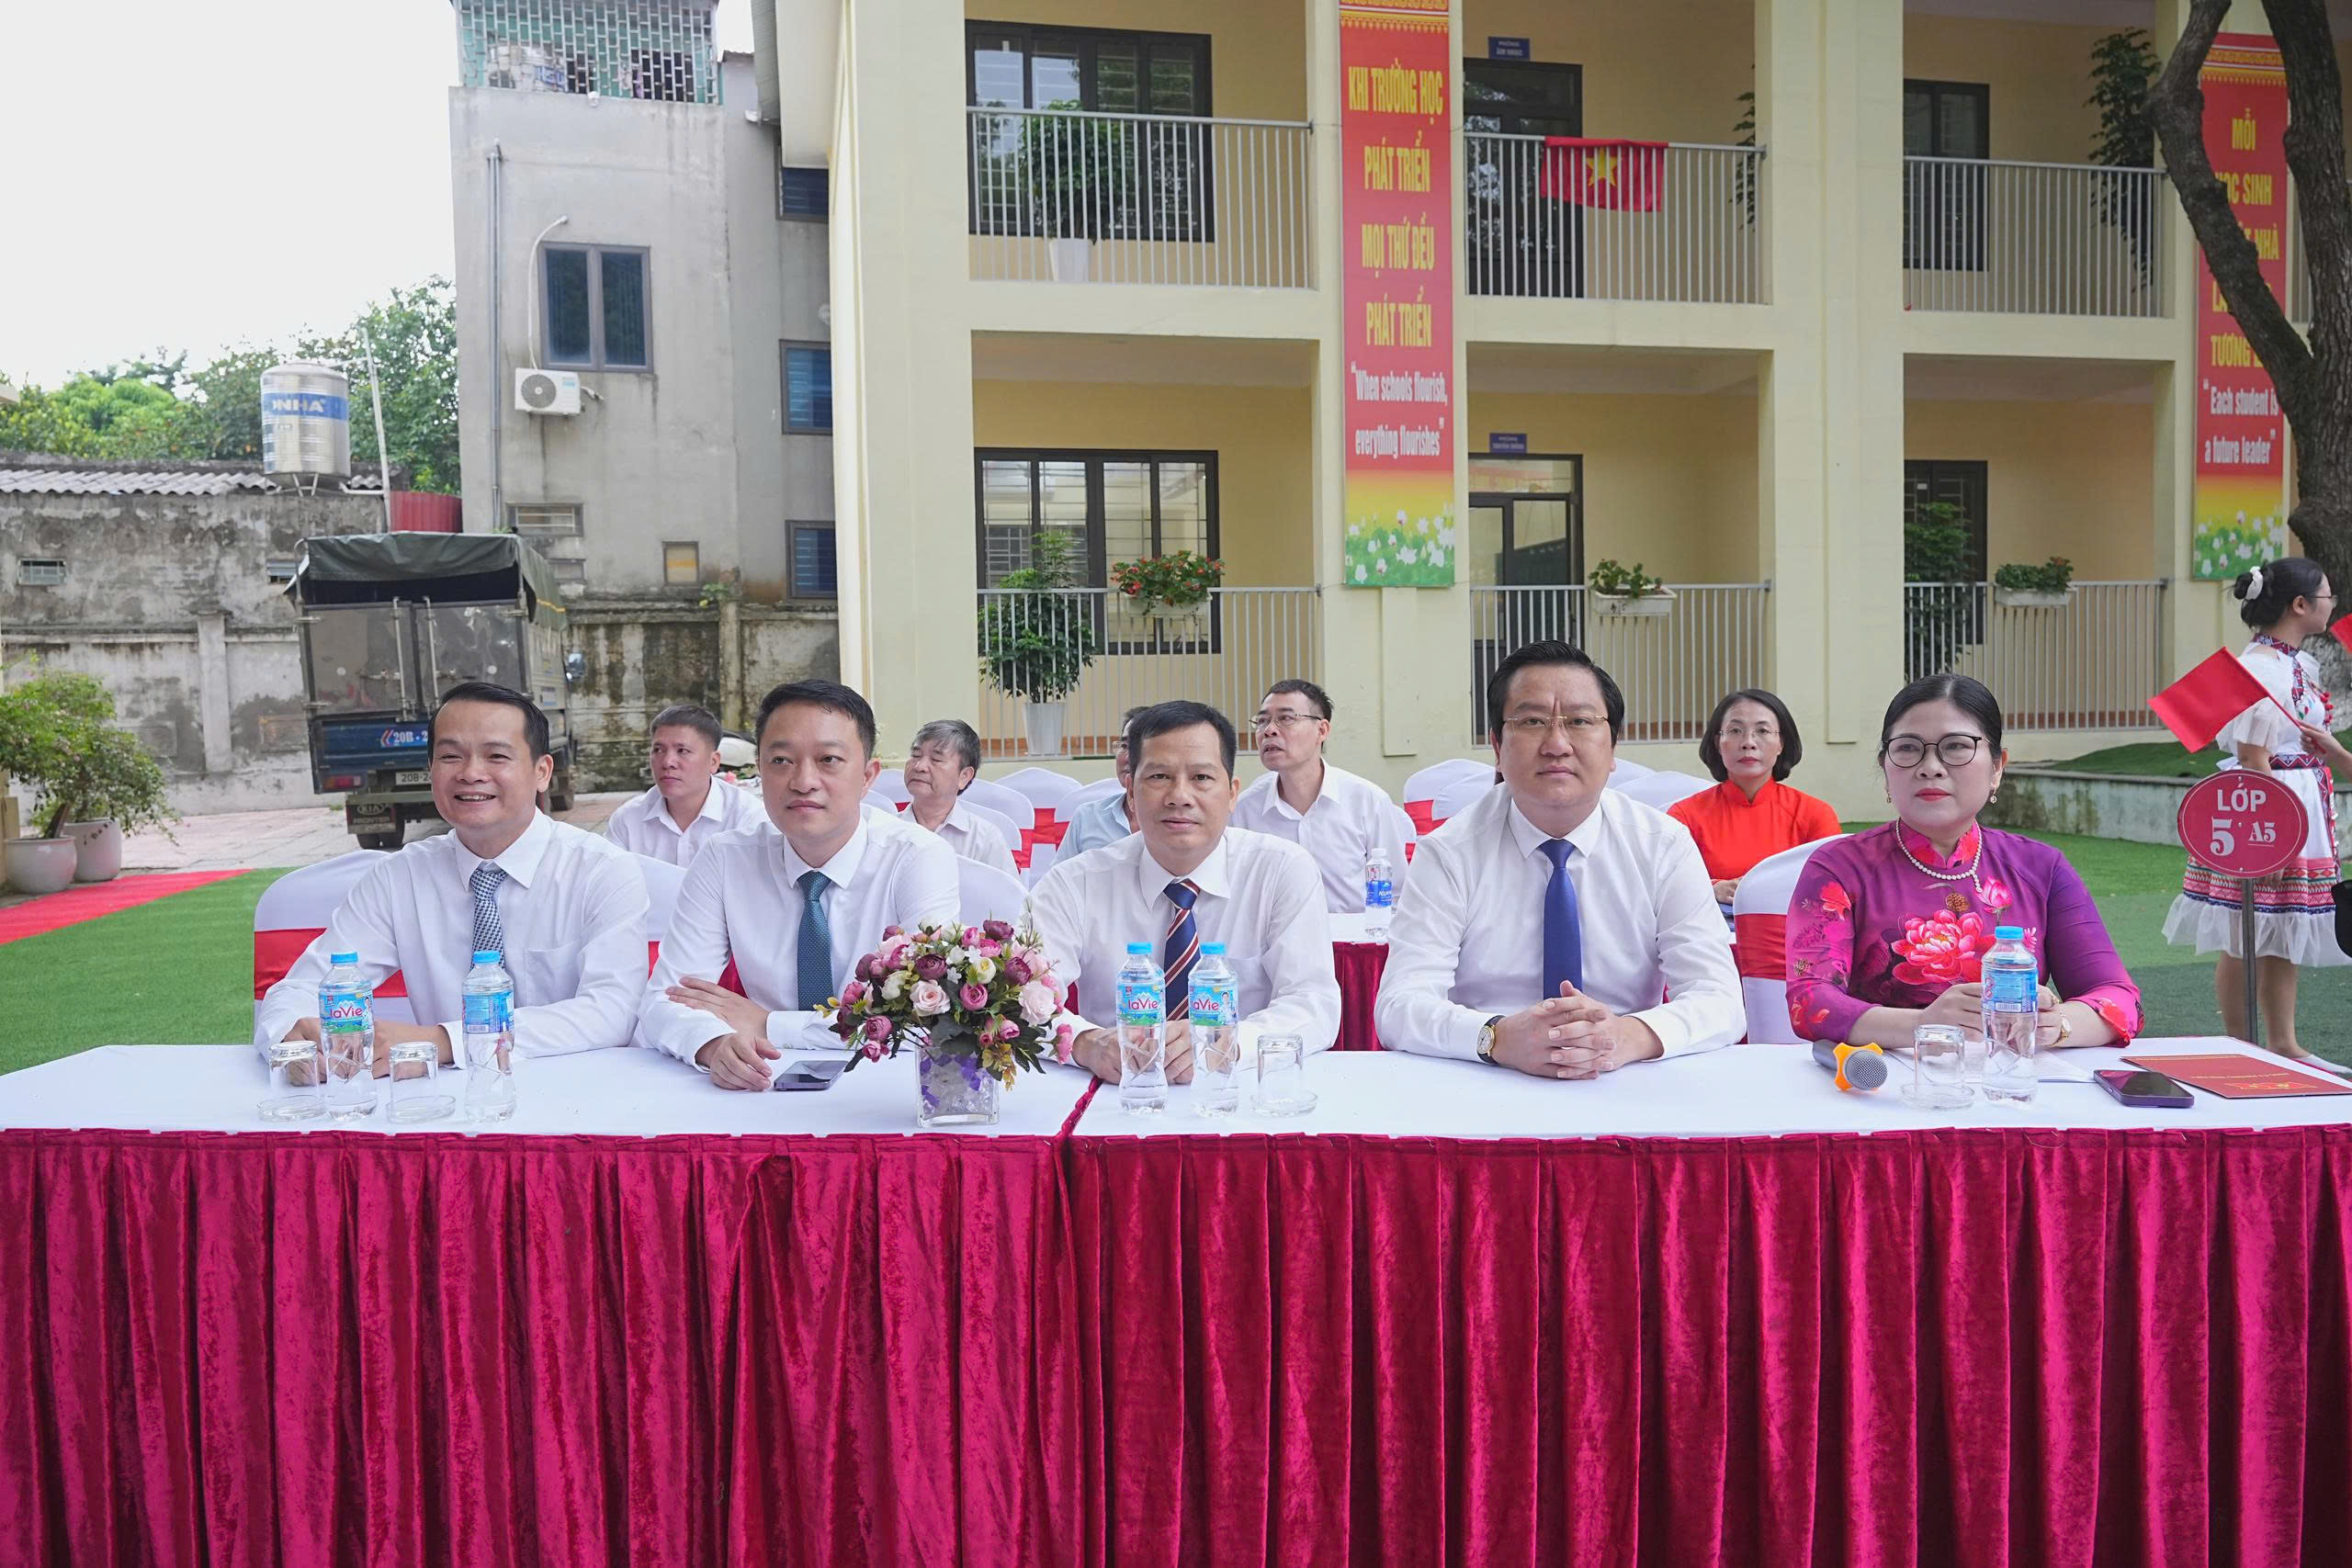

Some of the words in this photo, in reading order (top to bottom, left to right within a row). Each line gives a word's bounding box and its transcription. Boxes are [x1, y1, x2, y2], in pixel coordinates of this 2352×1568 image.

[1349, 66, 1368, 110] KHI
[1371, 58, 1417, 114] TRƯỜNG
[1419, 71, 1443, 125] HỌC
[1364, 136, 1395, 190] PHÁT
[1396, 130, 1430, 192] TRIỂN
[2243, 173, 2272, 206] SINH
[1362, 223, 1385, 278] MỌI
[1387, 216, 1410, 269] THỨ
[1366, 293, 1396, 345] PHÁT
[1398, 286, 1431, 347] TRIỂN
[1381, 370, 1413, 401] schools
[2235, 387, 2268, 415] student
[1355, 424, 1398, 459] everything
[2205, 440, 2211, 463] a
[2212, 435, 2240, 464] future
[401, 773, 431, 783] 20B-2
[2217, 783, 2267, 812] LỚP
[2210, 816, 2235, 856] 5
[2248, 820, 2277, 843] A5
